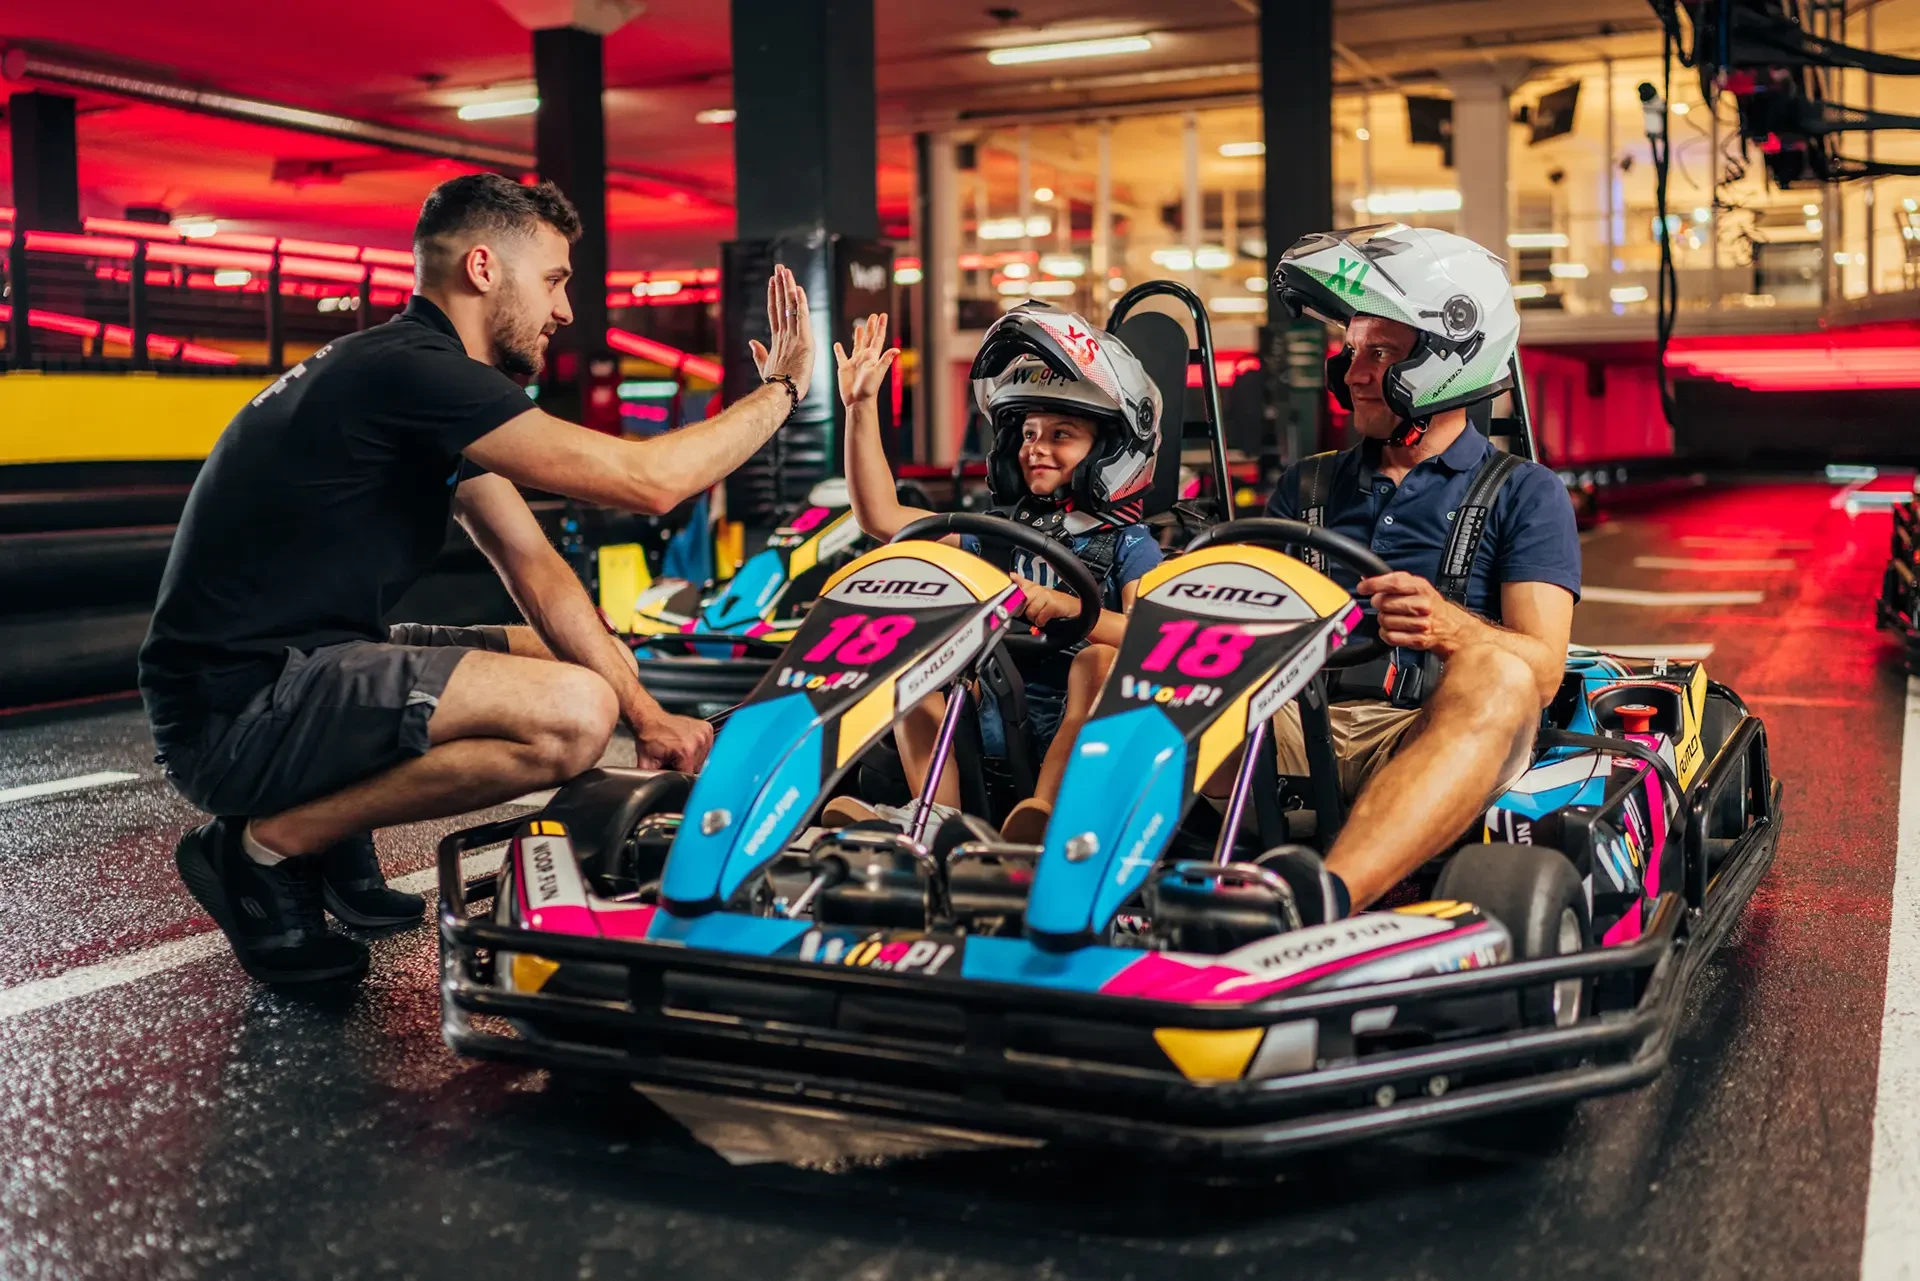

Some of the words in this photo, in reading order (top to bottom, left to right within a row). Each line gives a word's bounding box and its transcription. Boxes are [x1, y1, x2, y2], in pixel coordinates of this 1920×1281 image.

[1325, 257, 1369, 296] XL
[1064, 324, 1099, 365] XS
[802, 613, 917, 665] 18
[1140, 619, 1256, 678] 18
